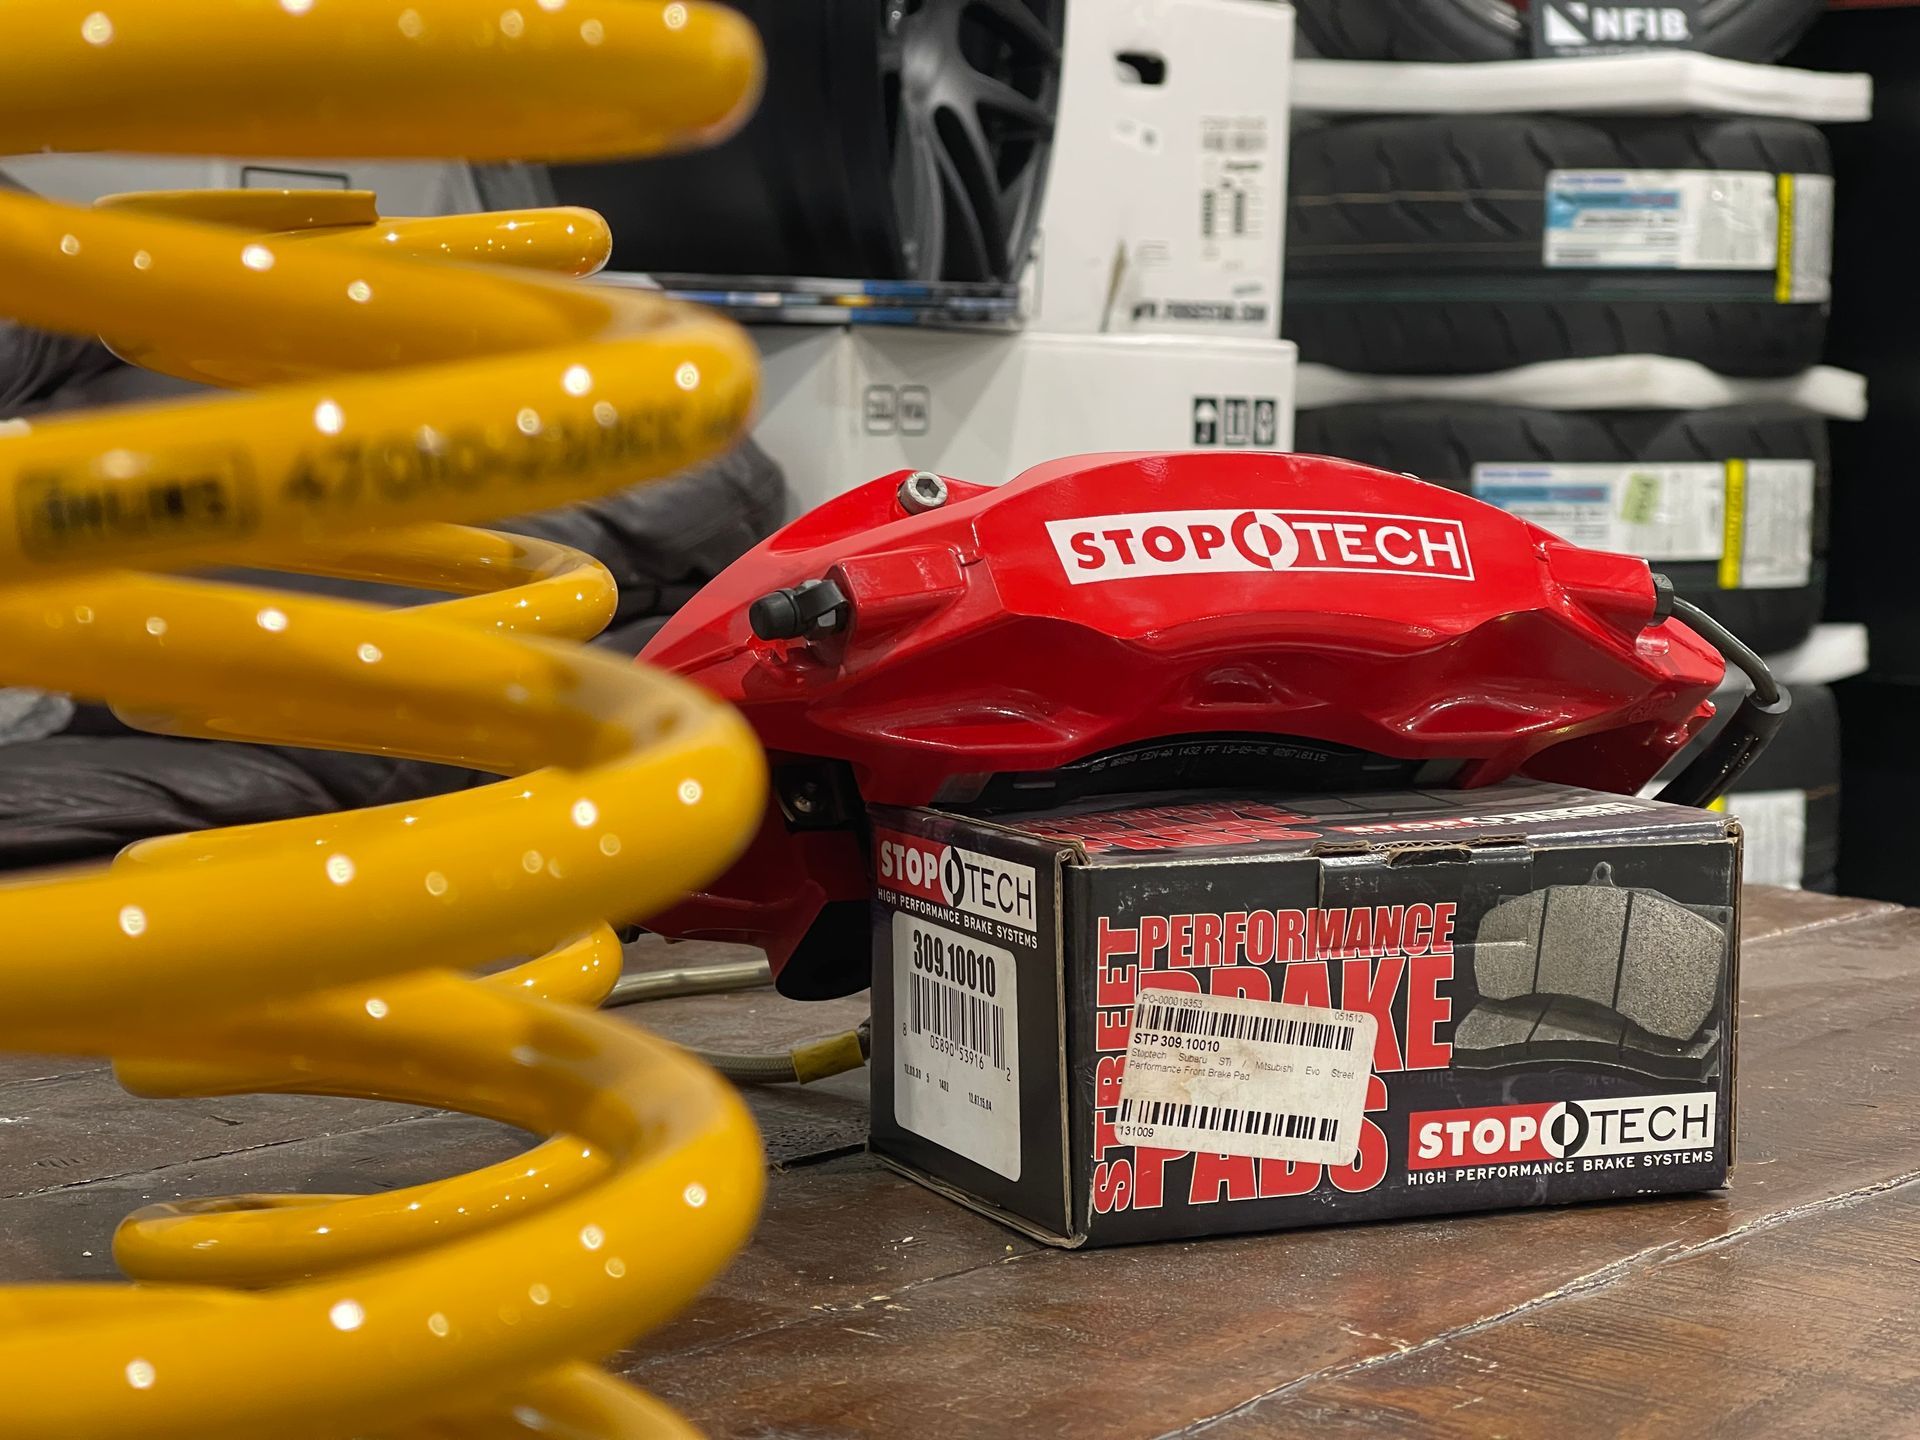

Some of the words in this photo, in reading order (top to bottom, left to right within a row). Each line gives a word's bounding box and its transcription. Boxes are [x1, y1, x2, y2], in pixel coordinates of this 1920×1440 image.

[1592, 7, 1688, 41] NFIB
[878, 888, 897, 905] HIGH
[900, 895, 960, 925] PERFORMANCE
[964, 915, 993, 935] BRAKE
[996, 926, 1038, 949] SYSTEMS
[1139, 902, 1457, 970] PERFORMANCE
[913, 929, 996, 997] 309.10010
[930, 1034, 955, 1057] 05890
[960, 1046, 984, 1070] 53916
[1134, 1032, 1158, 1046] STP
[1161, 1036, 1220, 1052] 309.10010
[1129, 1061, 1182, 1074] Performance
[1184, 1066, 1206, 1077] Front
[1208, 1068, 1231, 1079] Brake
[1233, 1070, 1250, 1080] Pad
[1131, 1048, 1167, 1060] Stoptech
[1178, 1053, 1208, 1064] Subaru
[1255, 1061, 1295, 1073] Mitsubishi
[1305, 1066, 1320, 1076] Evo
[1331, 1069, 1355, 1080] Street
[1119, 1125, 1154, 1138] 131009
[1407, 1171, 1447, 1186] HIGH
[1456, 1161, 1575, 1183] PERFORMANCE
[1584, 1156, 1635, 1172] BRAKE
[1643, 1150, 1714, 1167] SYSTEMS
